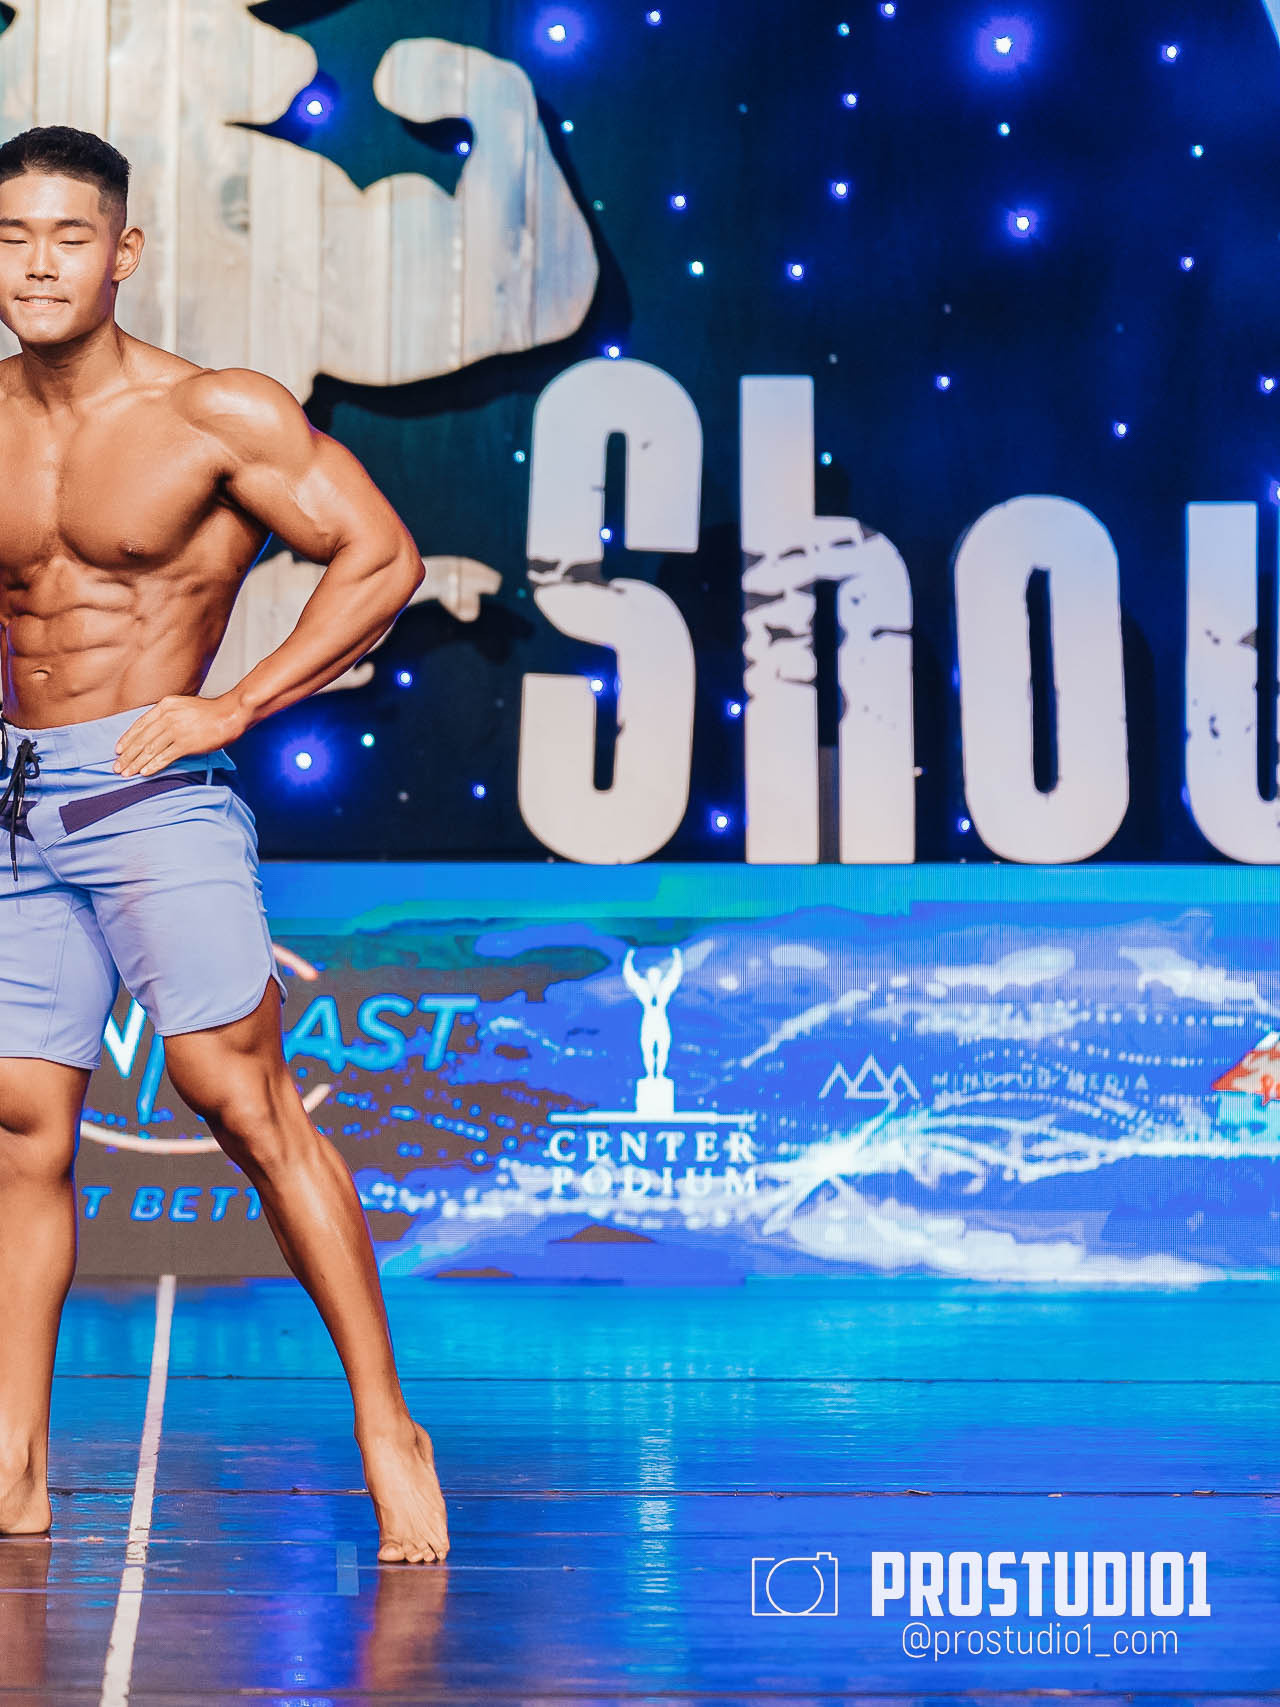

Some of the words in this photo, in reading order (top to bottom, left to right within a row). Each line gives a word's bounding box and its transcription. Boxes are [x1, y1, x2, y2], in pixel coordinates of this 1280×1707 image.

[549, 1131, 757, 1163] CENTER
[552, 1166, 758, 1197] PODIUM
[130, 1186, 264, 1222] BETT
